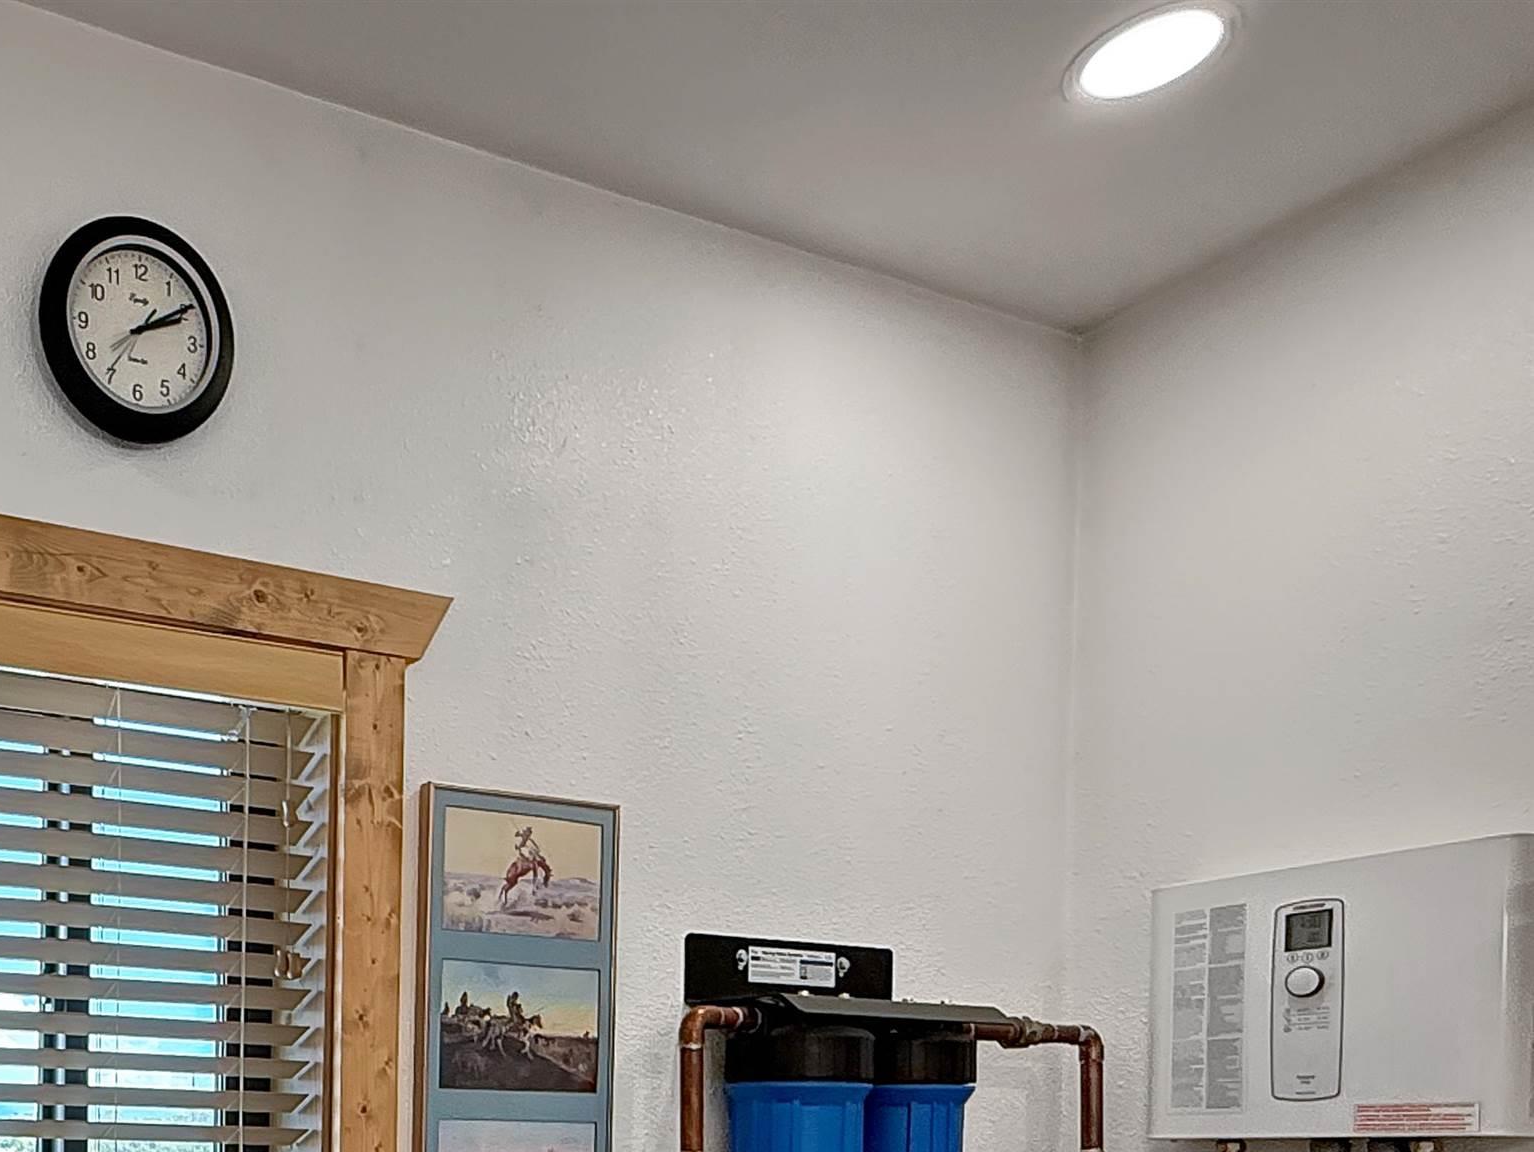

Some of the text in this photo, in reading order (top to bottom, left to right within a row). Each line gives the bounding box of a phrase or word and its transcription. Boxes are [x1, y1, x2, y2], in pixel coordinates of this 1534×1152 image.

[106, 267, 120, 285] 11
[132, 263, 149, 282] 12
[89, 283, 105, 301] 10
[165, 281, 172, 297] 1
[77, 311, 89, 329] 9
[85, 342, 97, 360] 8
[187, 336, 198, 354] 3
[106, 367, 117, 385] 7
[177, 362, 187, 380] 4
[132, 384, 143, 402] 6
[159, 379, 170, 398] 5
